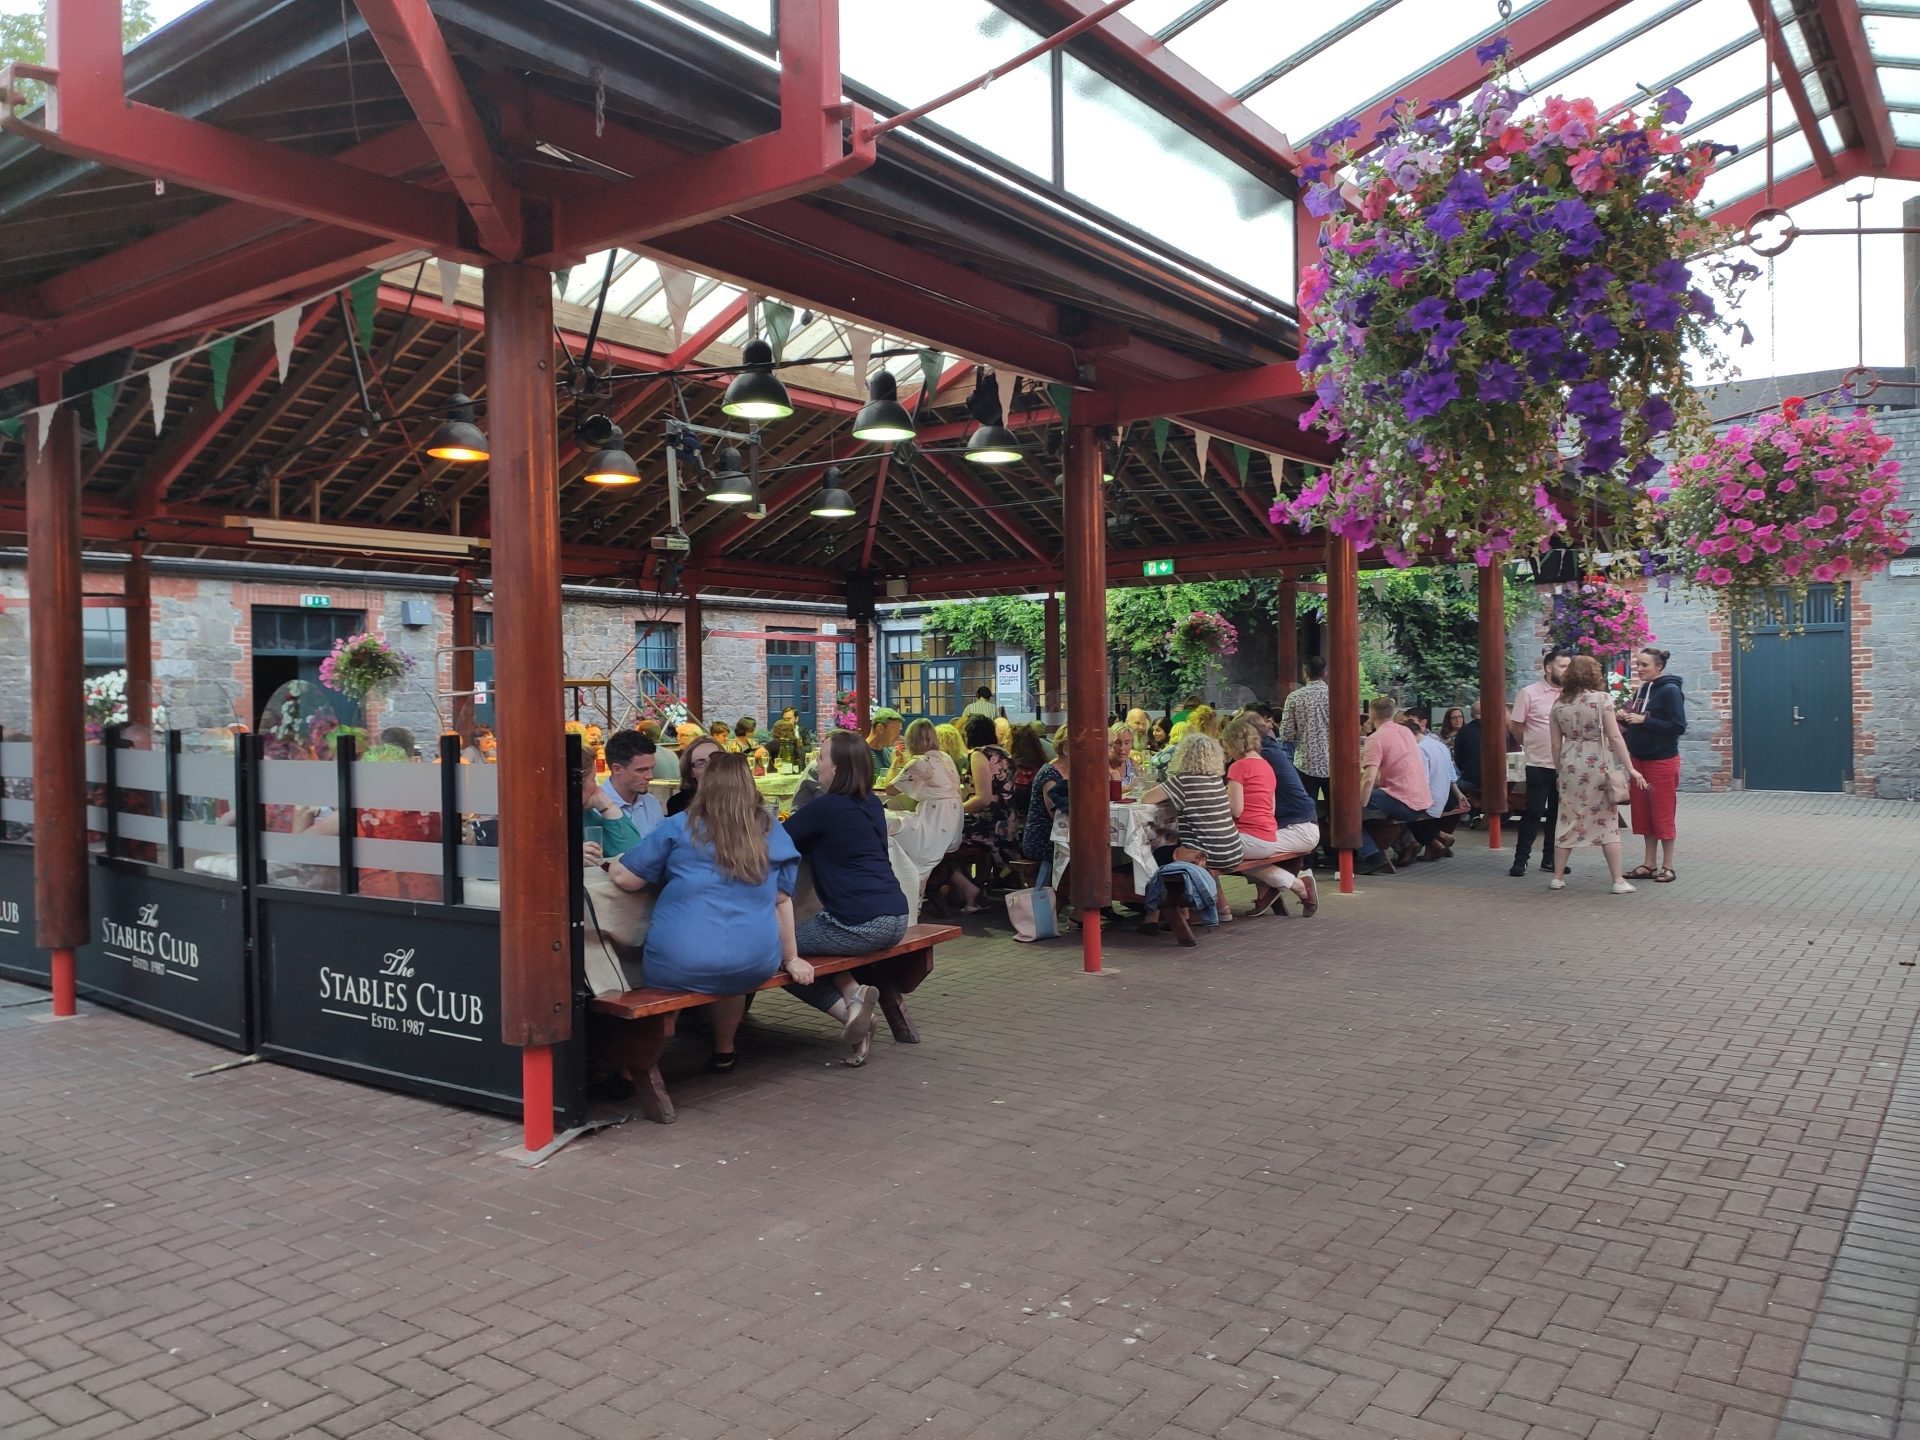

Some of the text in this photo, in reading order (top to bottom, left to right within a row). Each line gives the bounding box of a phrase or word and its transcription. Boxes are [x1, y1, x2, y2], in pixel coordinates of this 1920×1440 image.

[999, 664, 1019, 673] PSU
[102, 917, 199, 968] STABLES CLUB
[379, 948, 416, 978] The
[320, 966, 484, 1026] STABLES CLUB
[371, 1012, 425, 1037] ESTD. 1987
